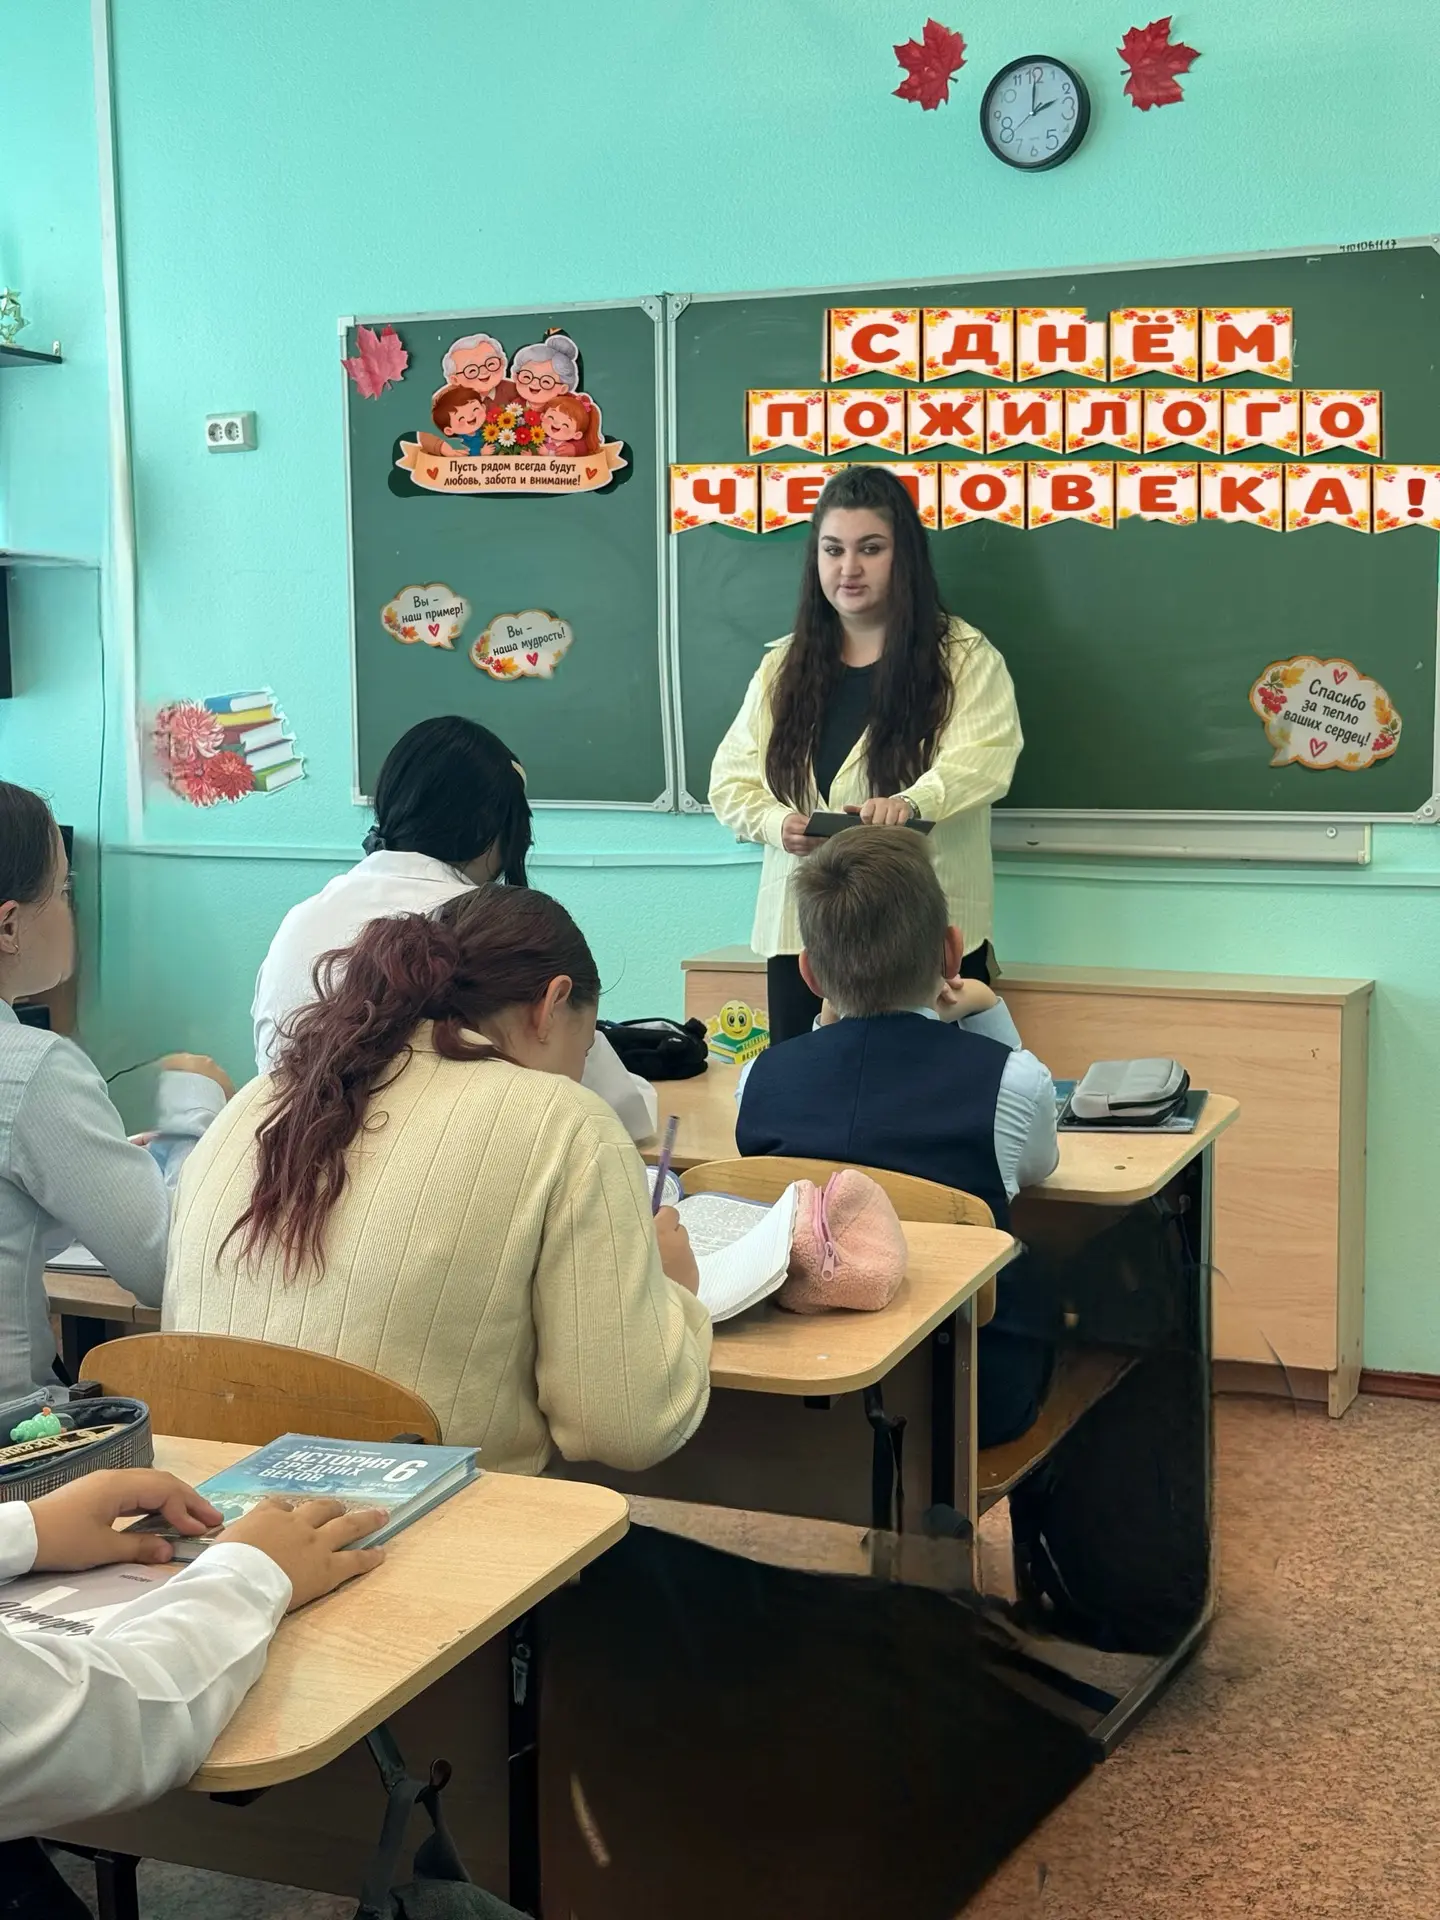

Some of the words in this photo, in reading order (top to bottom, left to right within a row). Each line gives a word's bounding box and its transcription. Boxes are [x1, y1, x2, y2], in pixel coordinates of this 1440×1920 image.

[1012, 74, 1022, 86] 11
[1025, 66, 1044, 84] 12
[1061, 82, 1071, 94] 2
[1061, 96, 1076, 121] 3
[999, 116, 1015, 143] 8
[1045, 128, 1059, 151] 5
[1015, 138, 1024, 155] 7
[1030, 144, 1039, 157] 6
[851, 323, 900, 364] С
[942, 315, 1275, 365] ДНЁМ
[767, 401, 1365, 438] ПОЖИЛОГО
[449, 460, 478, 475] Пусть
[481, 461, 511, 475] рядом
[514, 462, 547, 473] всегда
[549, 460, 577, 475] будут
[444, 473, 482, 487] любовь,
[484, 473, 517, 486] забота
[520, 475, 527, 485] и
[530, 474, 581, 487] внимание!
[413, 595, 430, 608] Вы
[401, 612, 422, 623] наш
[425, 602, 464, 622] пример!
[492, 643, 519, 656] наша
[521, 626, 566, 650] мудрость!
[506, 625, 524, 639] Вы
[1308, 678, 1367, 711] Спасибо
[1301, 699, 1317, 713] за
[1322, 704, 1359, 726] тепло
[1283, 710, 1322, 731] ваших
[1324, 722, 1372, 748] сердец!
[271, 1460, 366, 1477] СРЕДНИХ
[284, 1449, 397, 1471] ИСТОРИЯ
[258, 1468, 325, 1483] ВЕКОВ
[382, 1459, 429, 1483] 6
